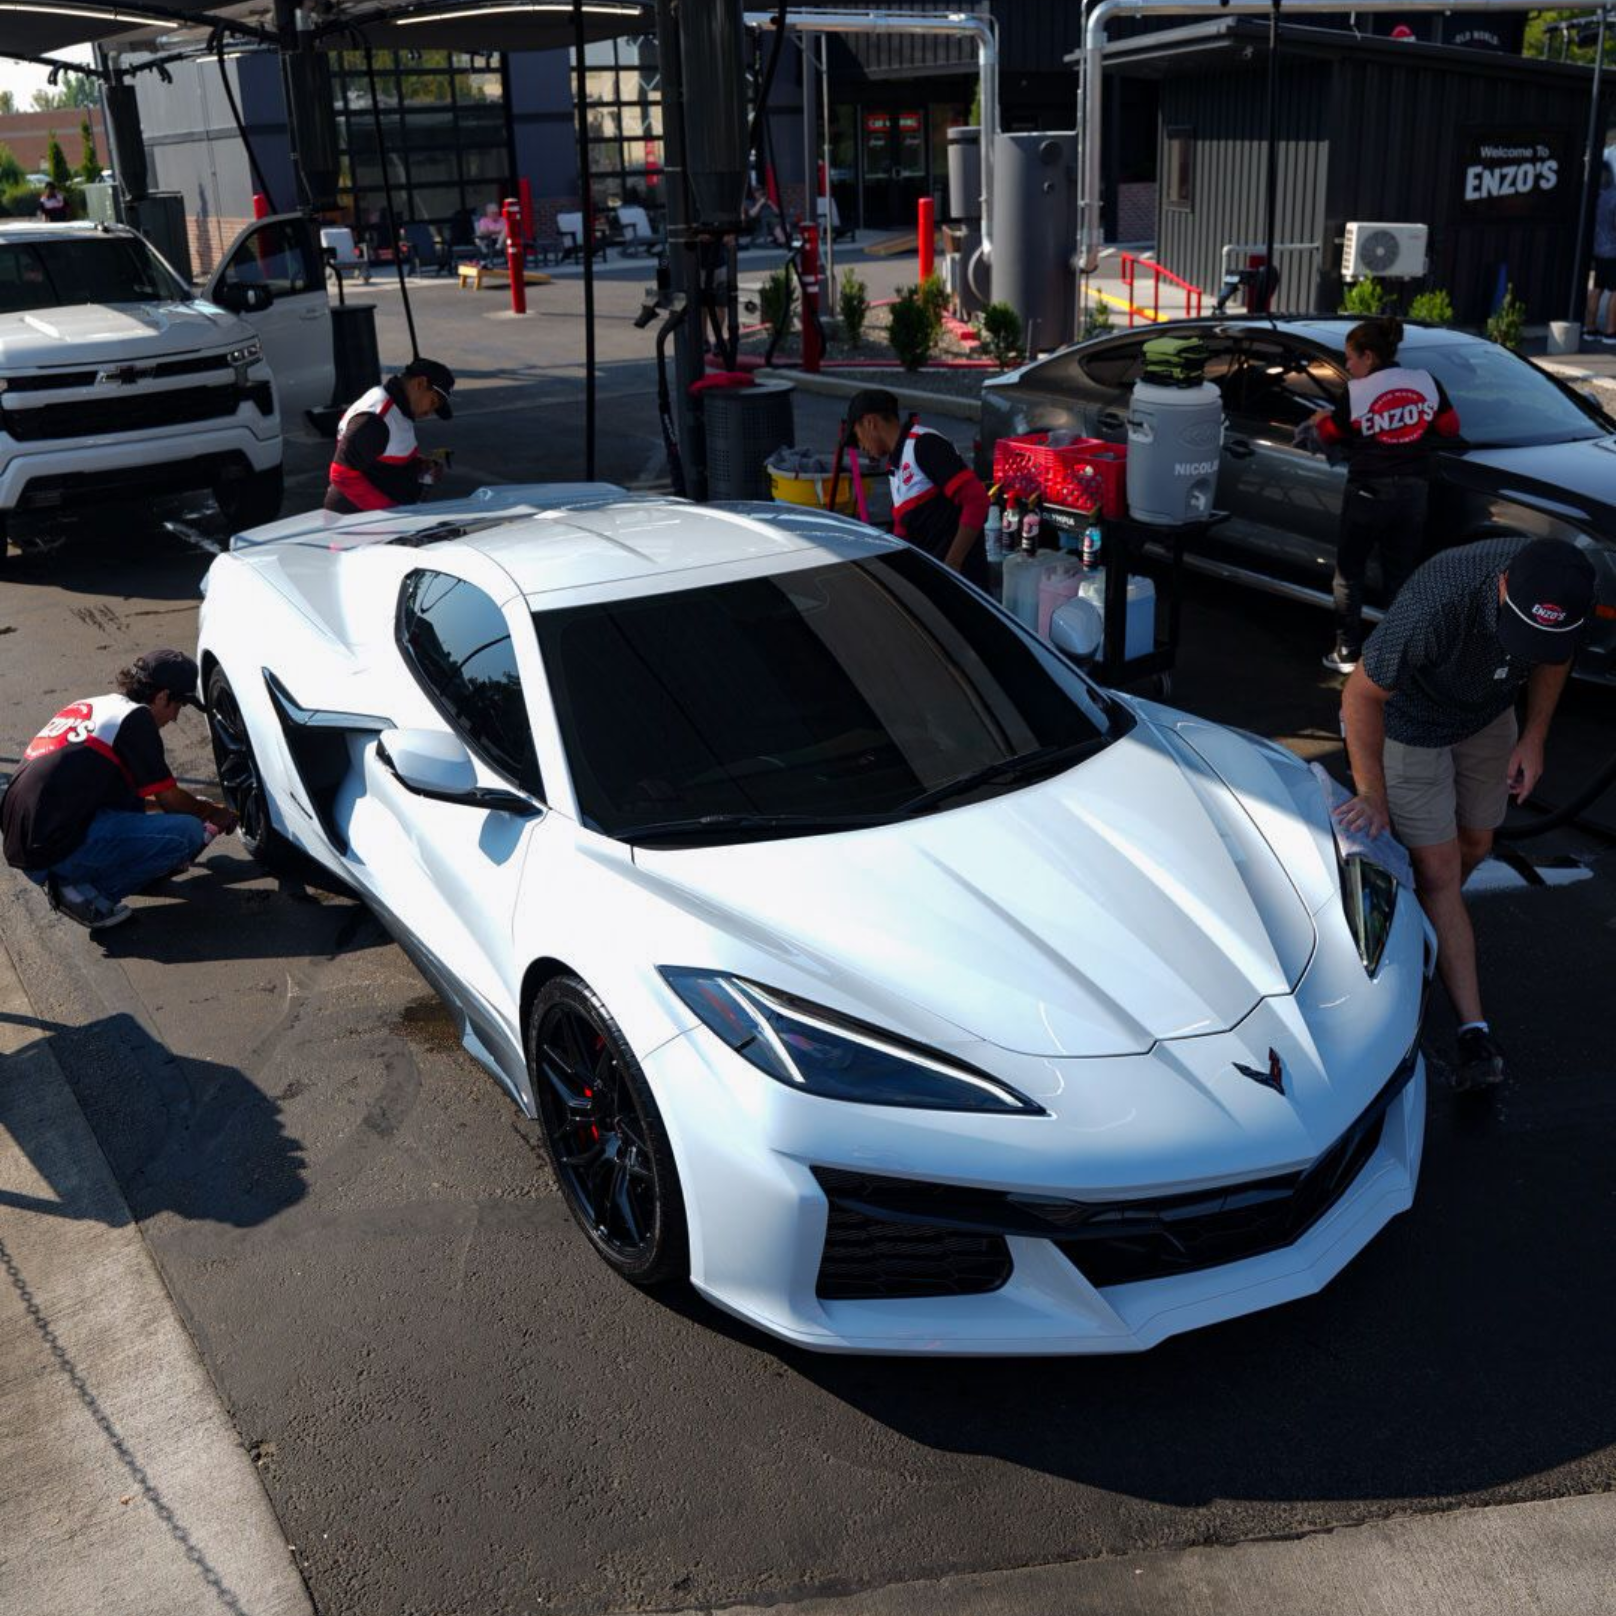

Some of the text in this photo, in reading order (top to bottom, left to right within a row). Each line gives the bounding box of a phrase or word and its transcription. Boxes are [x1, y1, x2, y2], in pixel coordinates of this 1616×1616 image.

[1480, 145, 1550, 158] Welcome To
[1465, 160, 1558, 200] ENZO'S
[1361, 401, 1437, 437] ENZO'S
